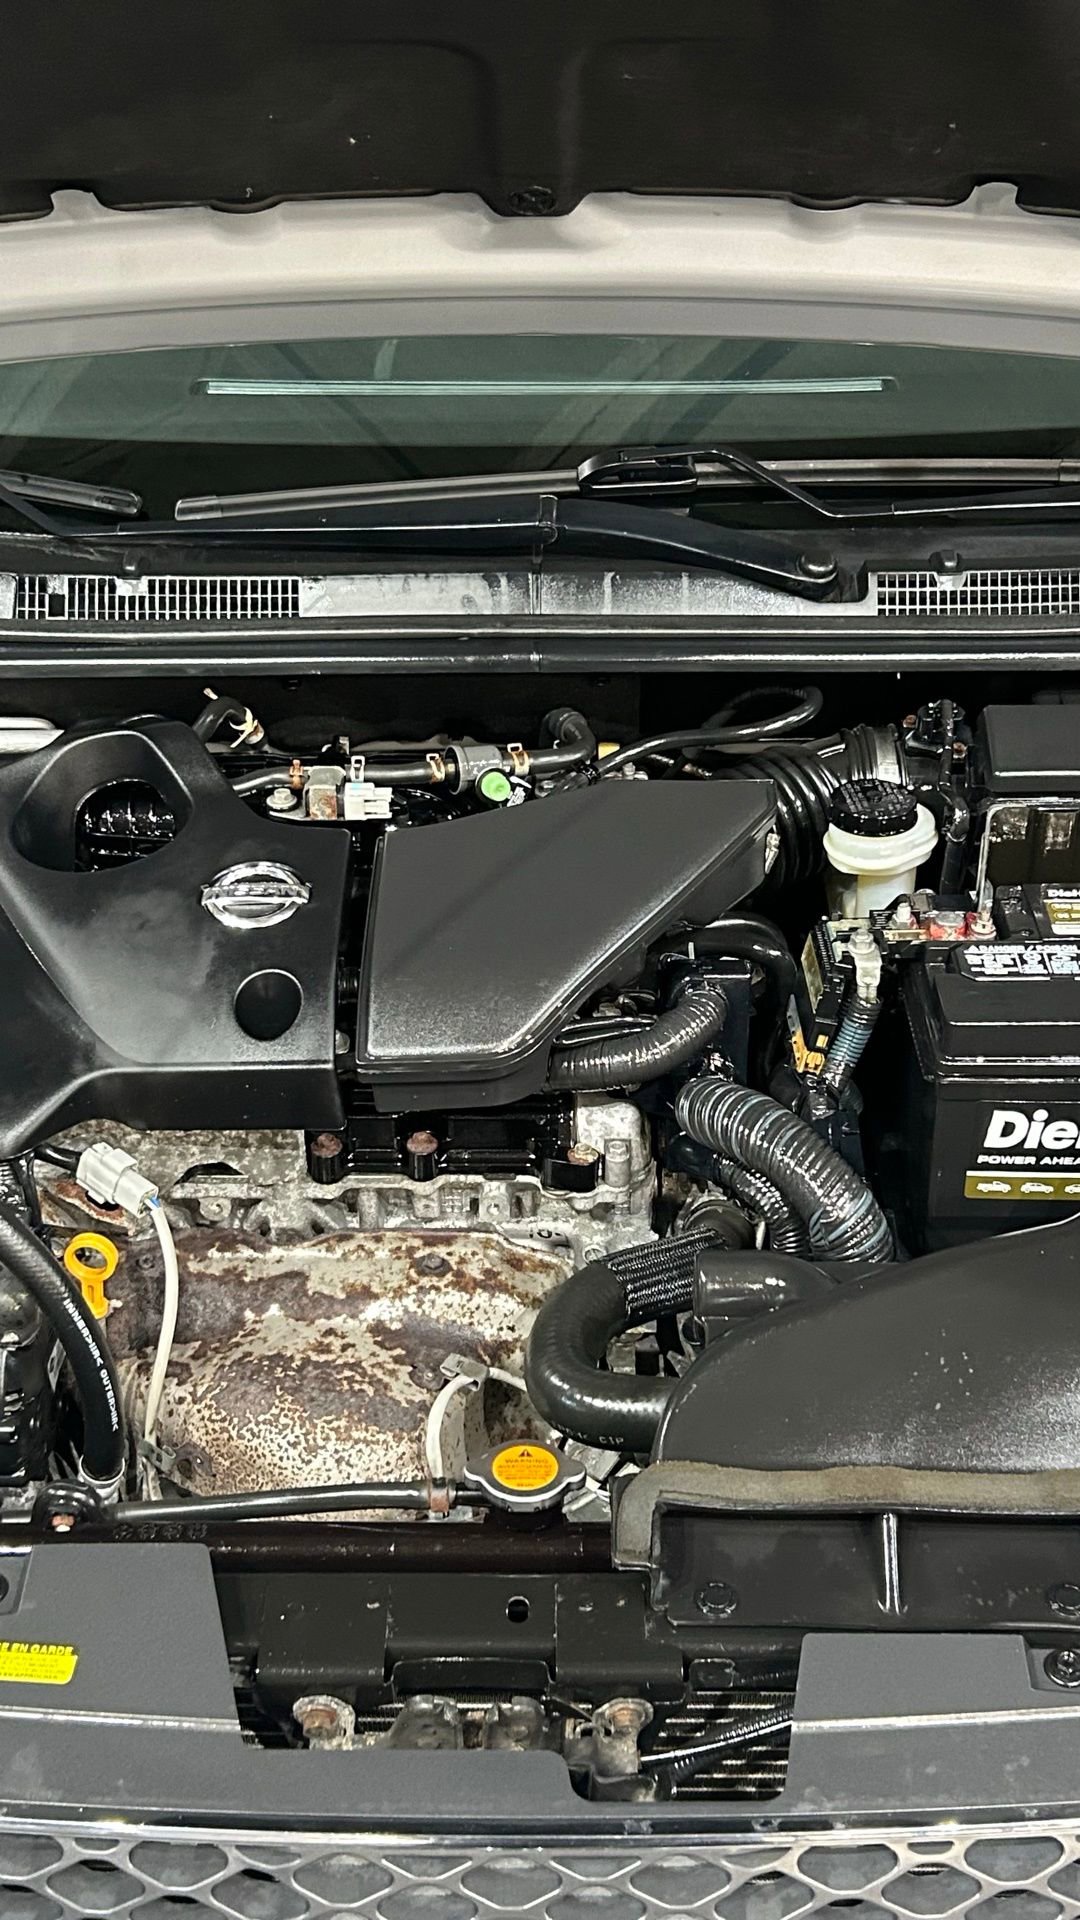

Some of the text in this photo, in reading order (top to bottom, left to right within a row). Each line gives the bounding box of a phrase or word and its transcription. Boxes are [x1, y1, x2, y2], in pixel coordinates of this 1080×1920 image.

[983, 1109, 1080, 1150] Die
[976, 1154, 1036, 1165] POWER
[0, 1642, 73, 1656] E EN GARDE
